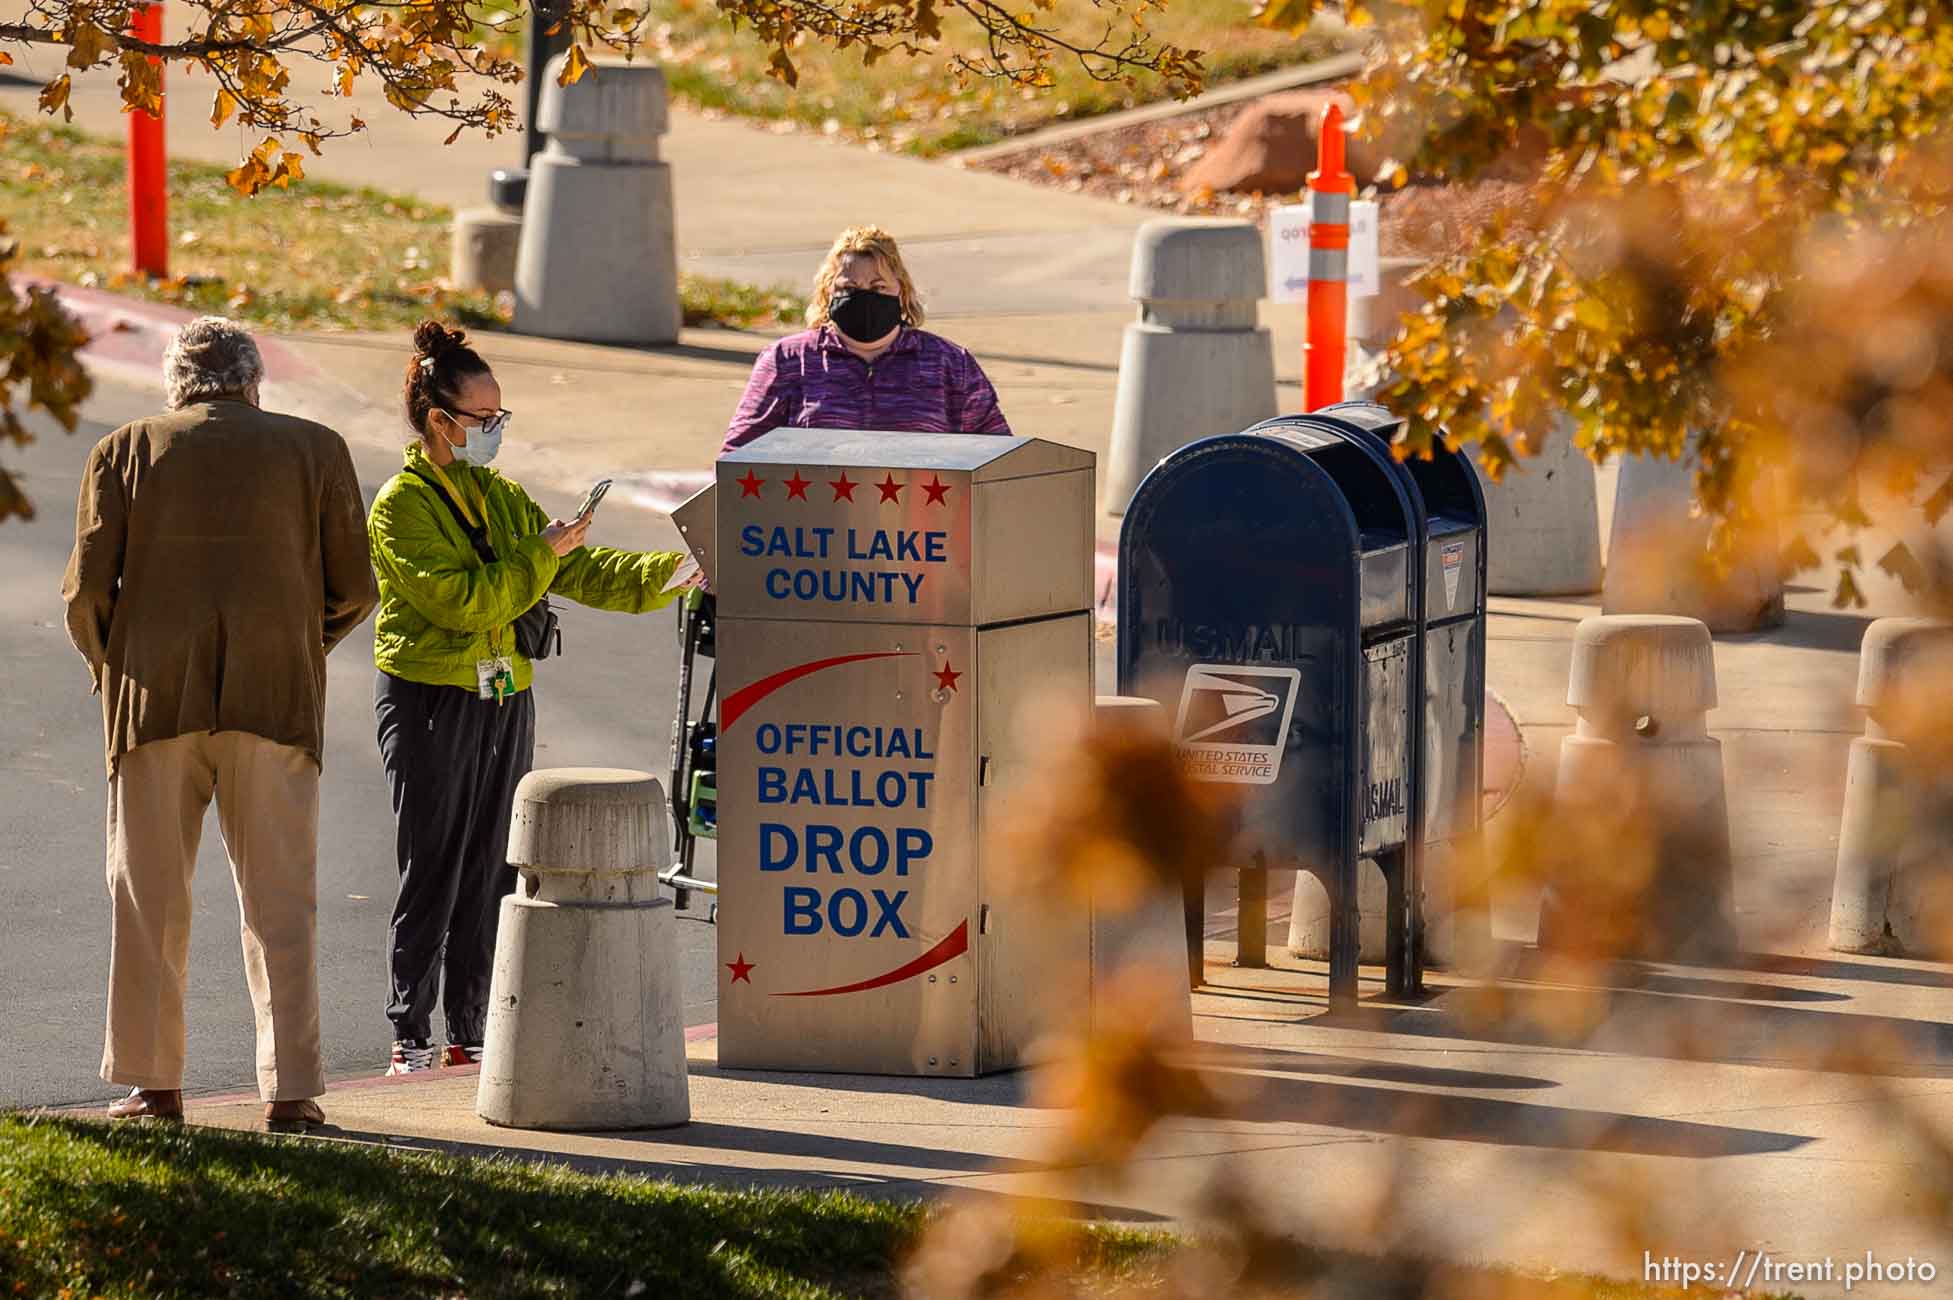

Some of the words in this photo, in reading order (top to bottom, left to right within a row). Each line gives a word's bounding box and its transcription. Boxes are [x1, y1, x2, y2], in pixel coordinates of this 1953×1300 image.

[742, 525, 834, 559] SALT
[848, 528, 948, 562] LAKE
[766, 569, 925, 604] COUNTY
[757, 724, 934, 760] OFFICIAL
[1176, 747, 1224, 761] UNITED
[1224, 751, 1268, 763] STATES
[758, 767, 935, 809] BALLOT
[1222, 765, 1272, 777] SERVICE
[759, 823, 934, 876] DROP
[784, 886, 911, 938] BOX
